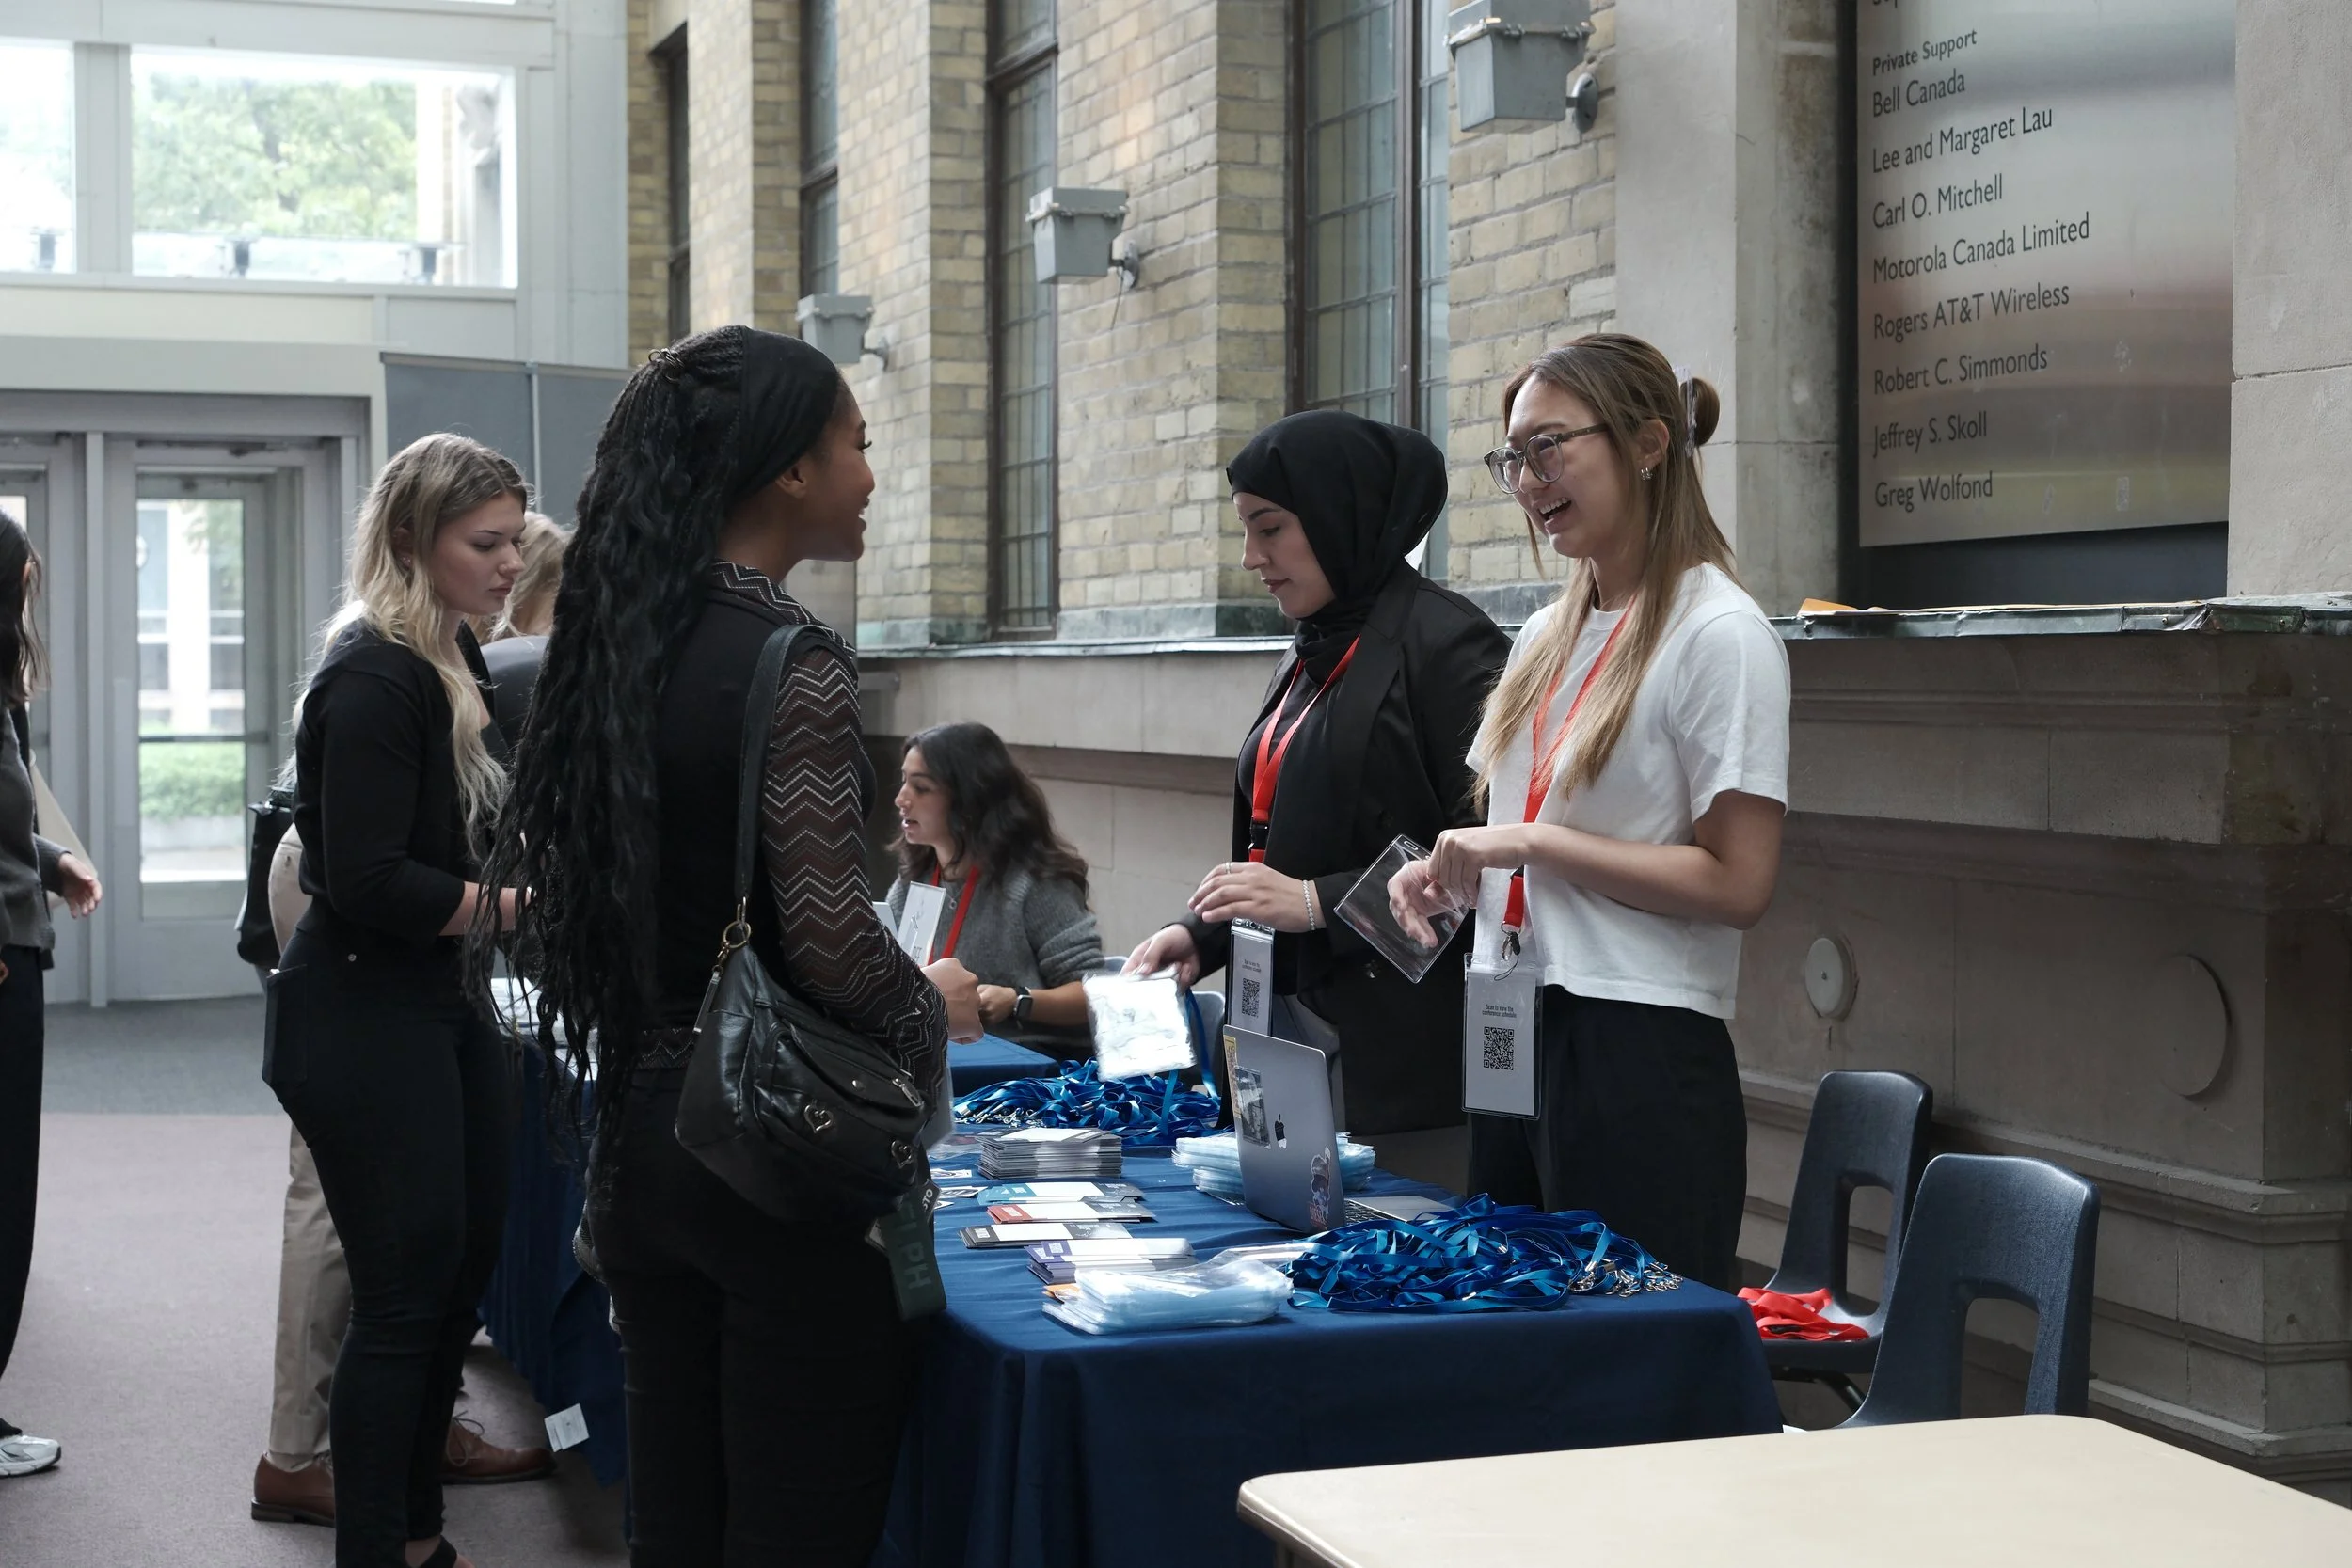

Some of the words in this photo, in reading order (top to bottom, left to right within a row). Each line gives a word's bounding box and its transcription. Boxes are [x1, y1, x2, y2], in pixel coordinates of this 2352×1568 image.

[1873, 50, 1918, 76] Private
[1922, 28, 1978, 61] Support
[1873, 84, 1900, 118] Bell
[1906, 67, 1966, 106] Canada
[1873, 148, 1900, 173] Lee
[1905, 133, 1933, 166] and
[1939, 117, 2016, 155] Margaret
[2022, 106, 2053, 134] Lau
[1872, 196, 1906, 229] Carl
[1911, 192, 1931, 219] O.
[1938, 173, 2003, 214] Mitchell
[1873, 245, 1947, 284] Motorola
[1952, 230, 2015, 266] Canada
[2022, 211, 2090, 252] Limited
[1873, 312, 1928, 343] Rogers
[1933, 293, 1985, 329] AT&T
[1990, 282, 2070, 316] Wireless
[1873, 368, 1930, 395] Robert
[1934, 358, 1953, 385] C.
[1959, 343, 2047, 381] Simmonds
[1872, 422, 1923, 458] Jeffrey
[1929, 418, 1943, 443] S.
[1947, 411, 1988, 441] Skoll
[1874, 481, 1915, 513] Greg
[1918, 470, 1994, 502] Wolfond
